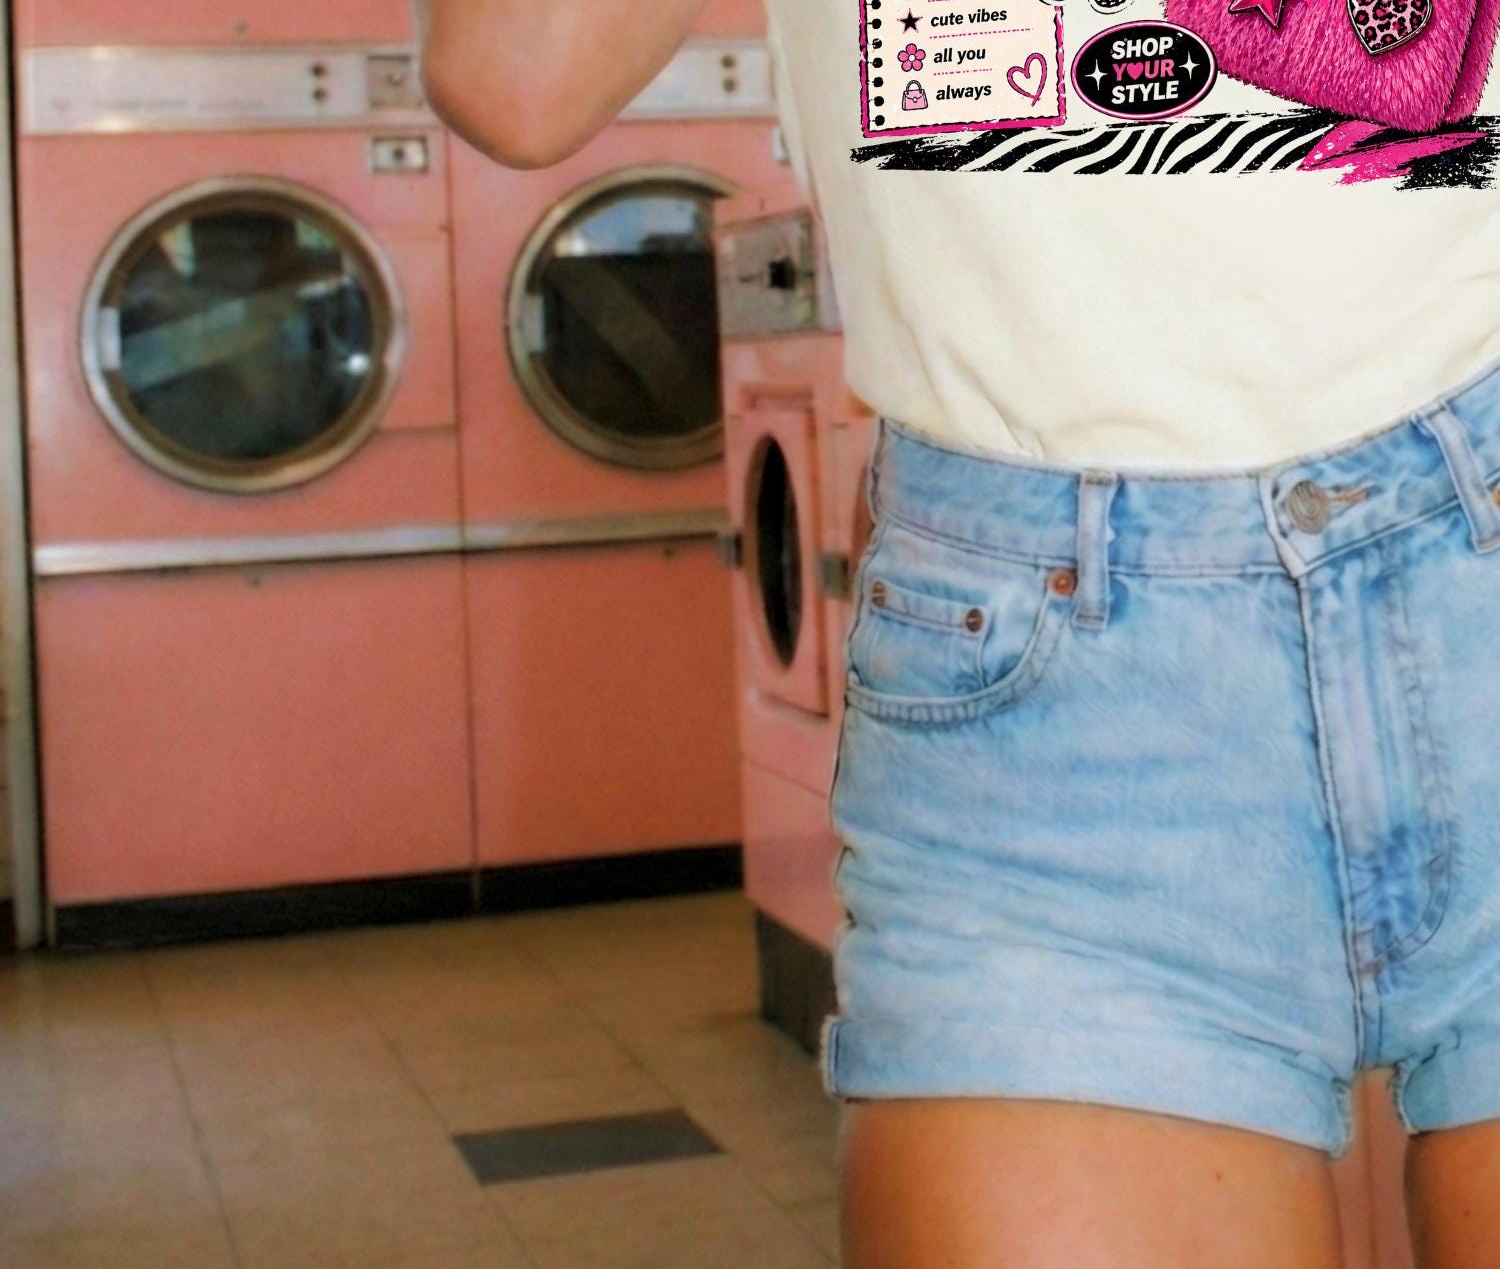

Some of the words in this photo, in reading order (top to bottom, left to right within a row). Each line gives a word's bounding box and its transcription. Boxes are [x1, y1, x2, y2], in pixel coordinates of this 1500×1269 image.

[930, 12, 964, 27] cute
[968, 9, 1008, 24] vibes
[933, 47, 953, 63] all
[957, 48, 986, 65] you
[1111, 36, 1174, 60] SHOP
[935, 84, 992, 101] always
[1111, 80, 1179, 105] STYLE
